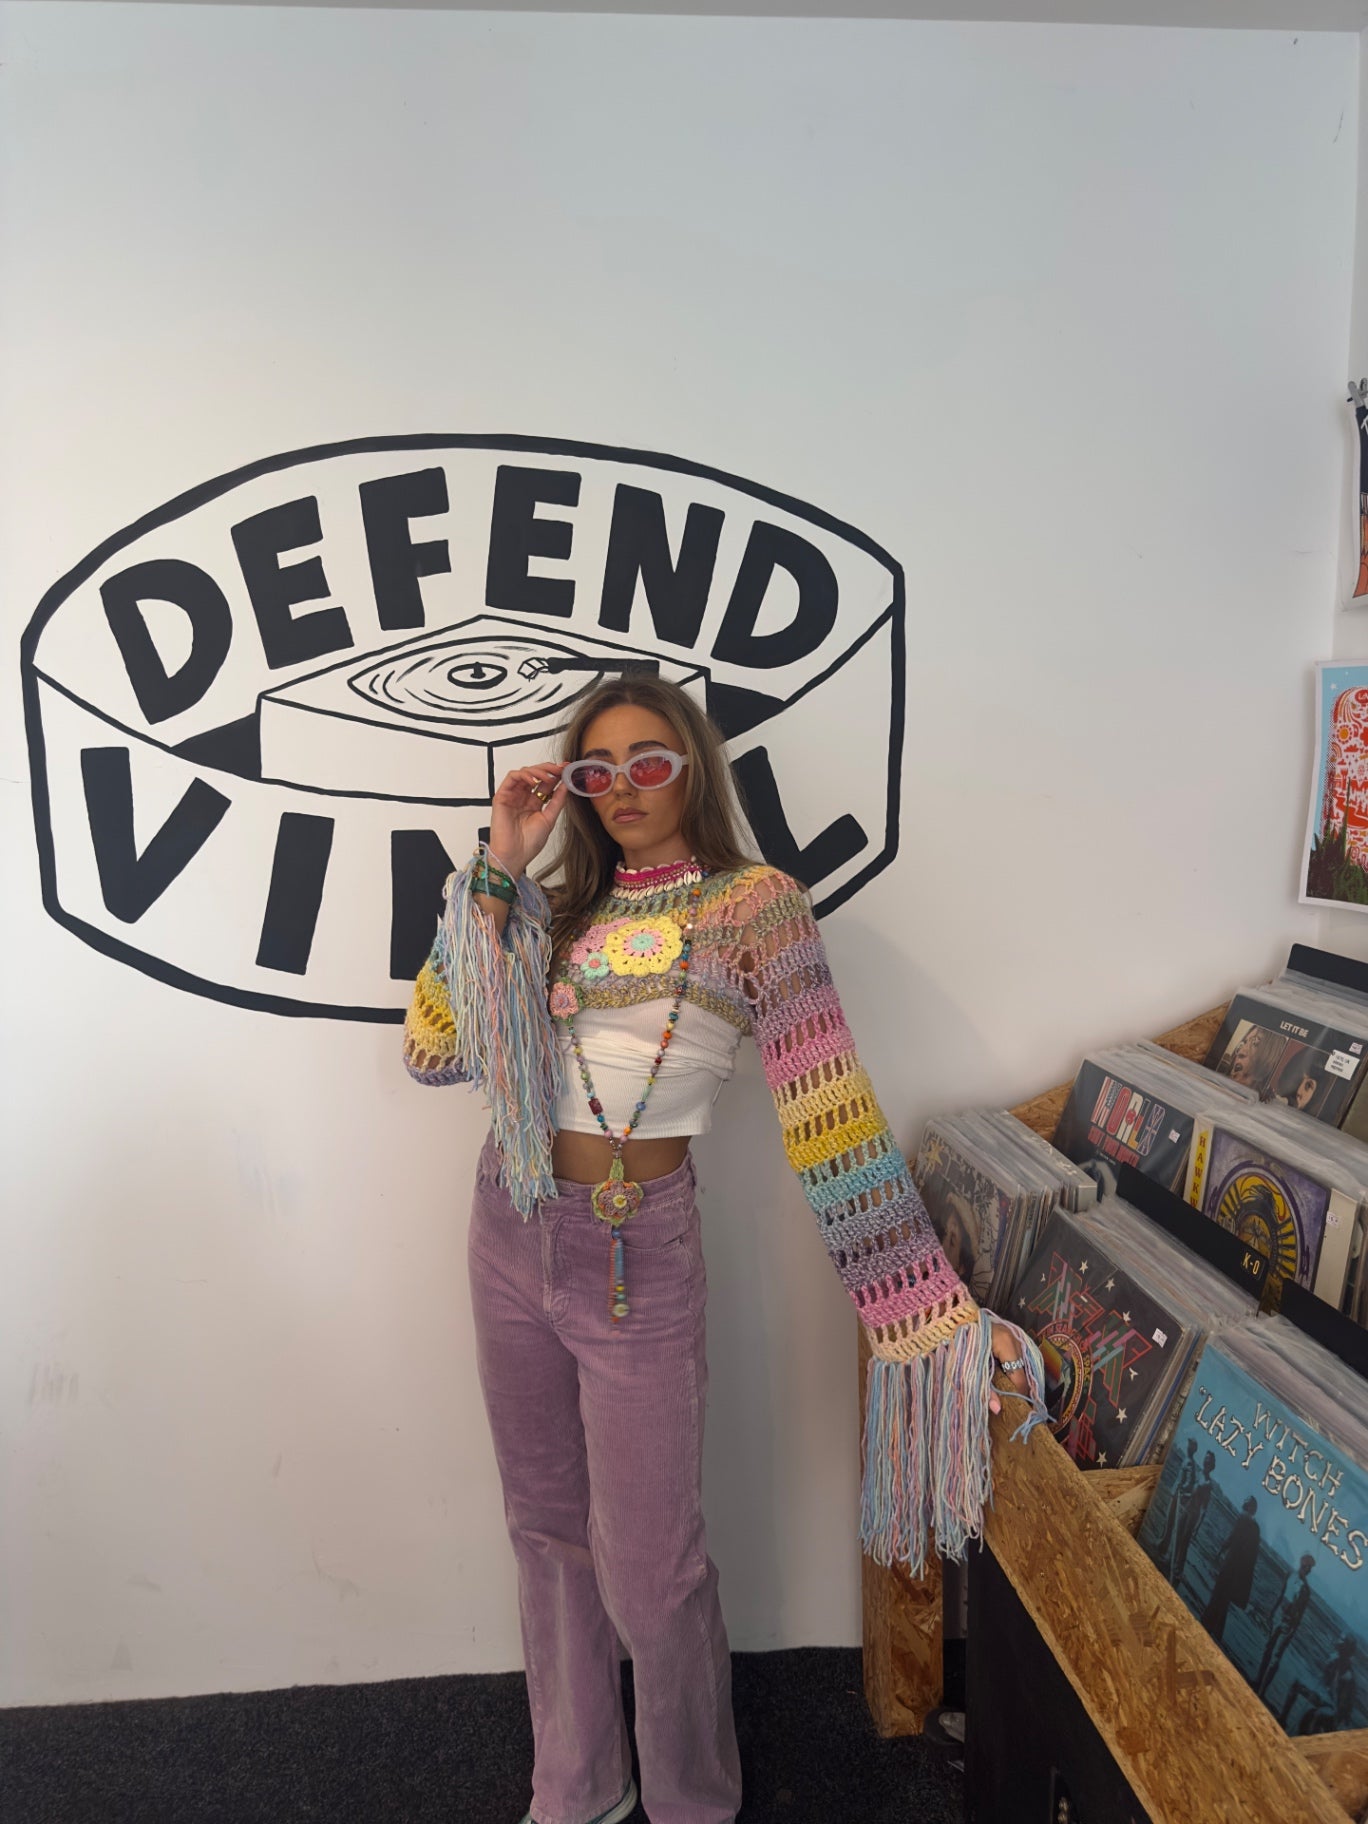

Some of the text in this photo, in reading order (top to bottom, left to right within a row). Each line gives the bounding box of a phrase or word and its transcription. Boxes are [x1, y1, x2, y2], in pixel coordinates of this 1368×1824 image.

[99, 465, 838, 724] DEFEND
[81, 746, 868, 980] VINL
[1280, 1021, 1293, 1031] LET
[1253, 1402, 1344, 1496] WITCH
[1262, 1455, 1368, 1570] BONES
